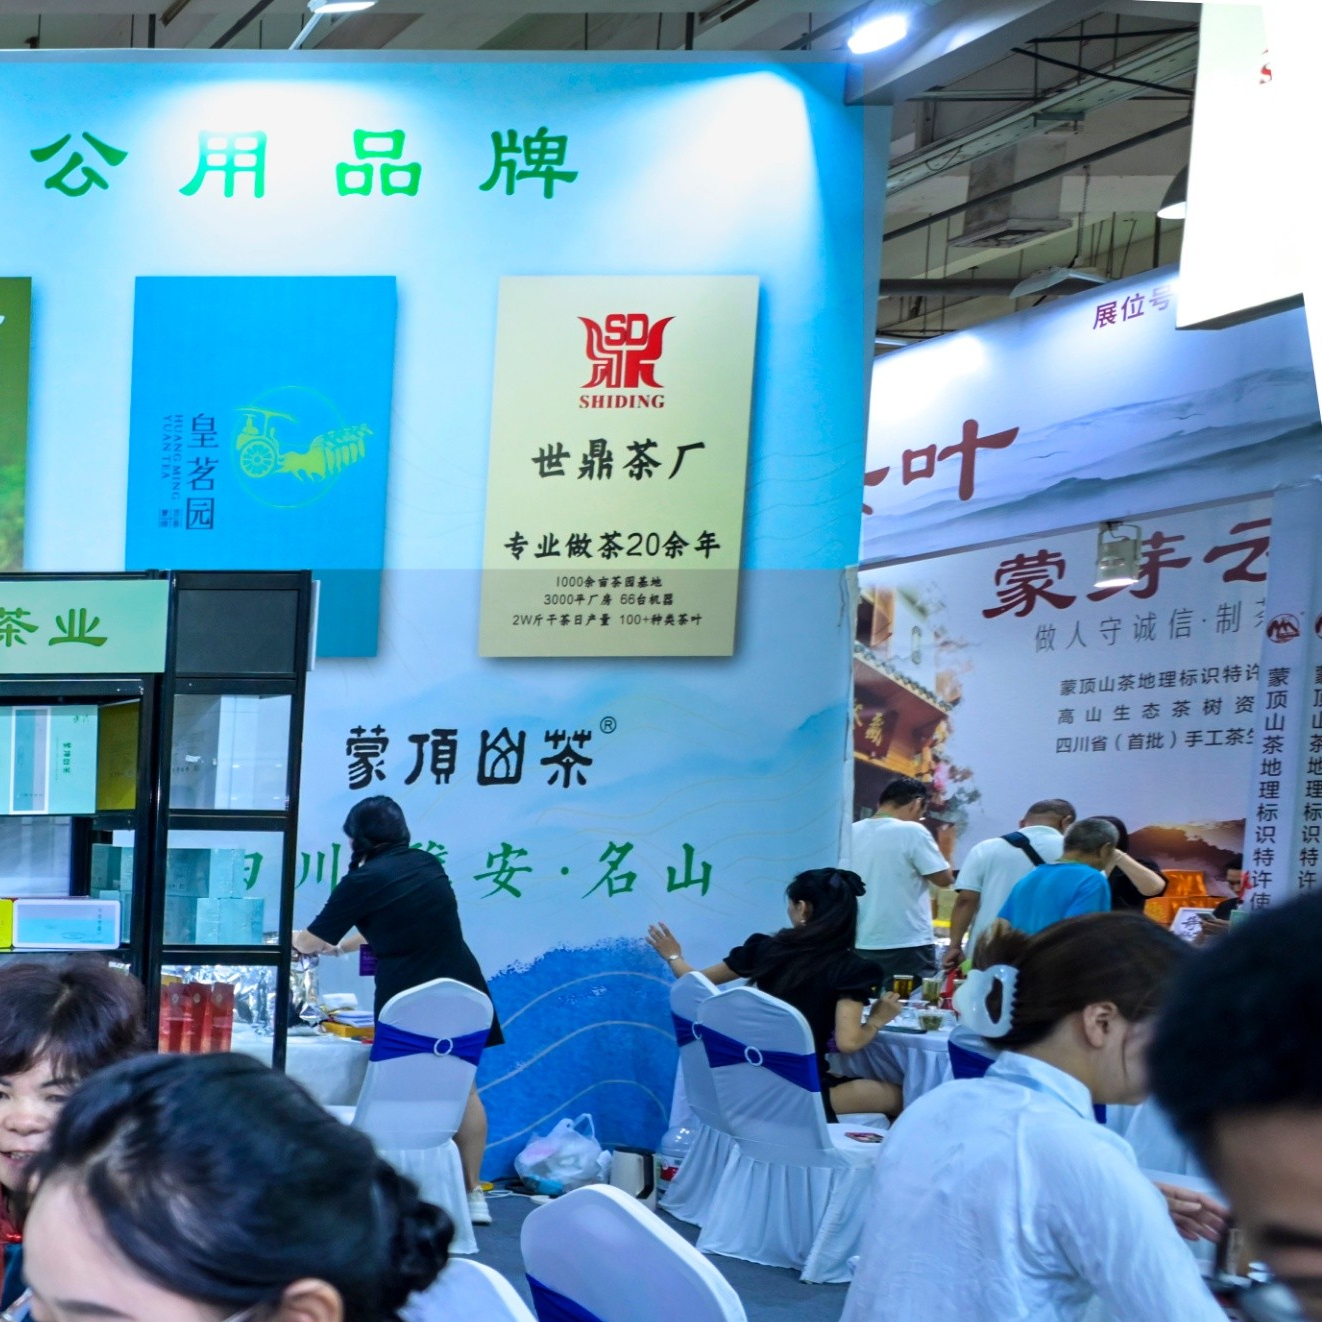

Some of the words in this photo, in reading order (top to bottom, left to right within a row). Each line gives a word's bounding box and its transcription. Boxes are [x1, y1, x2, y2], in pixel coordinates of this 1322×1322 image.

[1093, 285, 1173, 330] 展位号
[579, 394, 665, 408] SHIDING
[531, 438, 706, 480] 世鼎茶厂
[186, 413, 219, 530] 皇茗园
[504, 530, 721, 560] 专业做茶20余年
[556, 576, 663, 588] 1000余亩茶园基地
[544, 593, 612, 606] 3000平厂房
[620, 593, 674, 606] 66台机器
[620, 613, 703, 626] 100+种类茶叶
